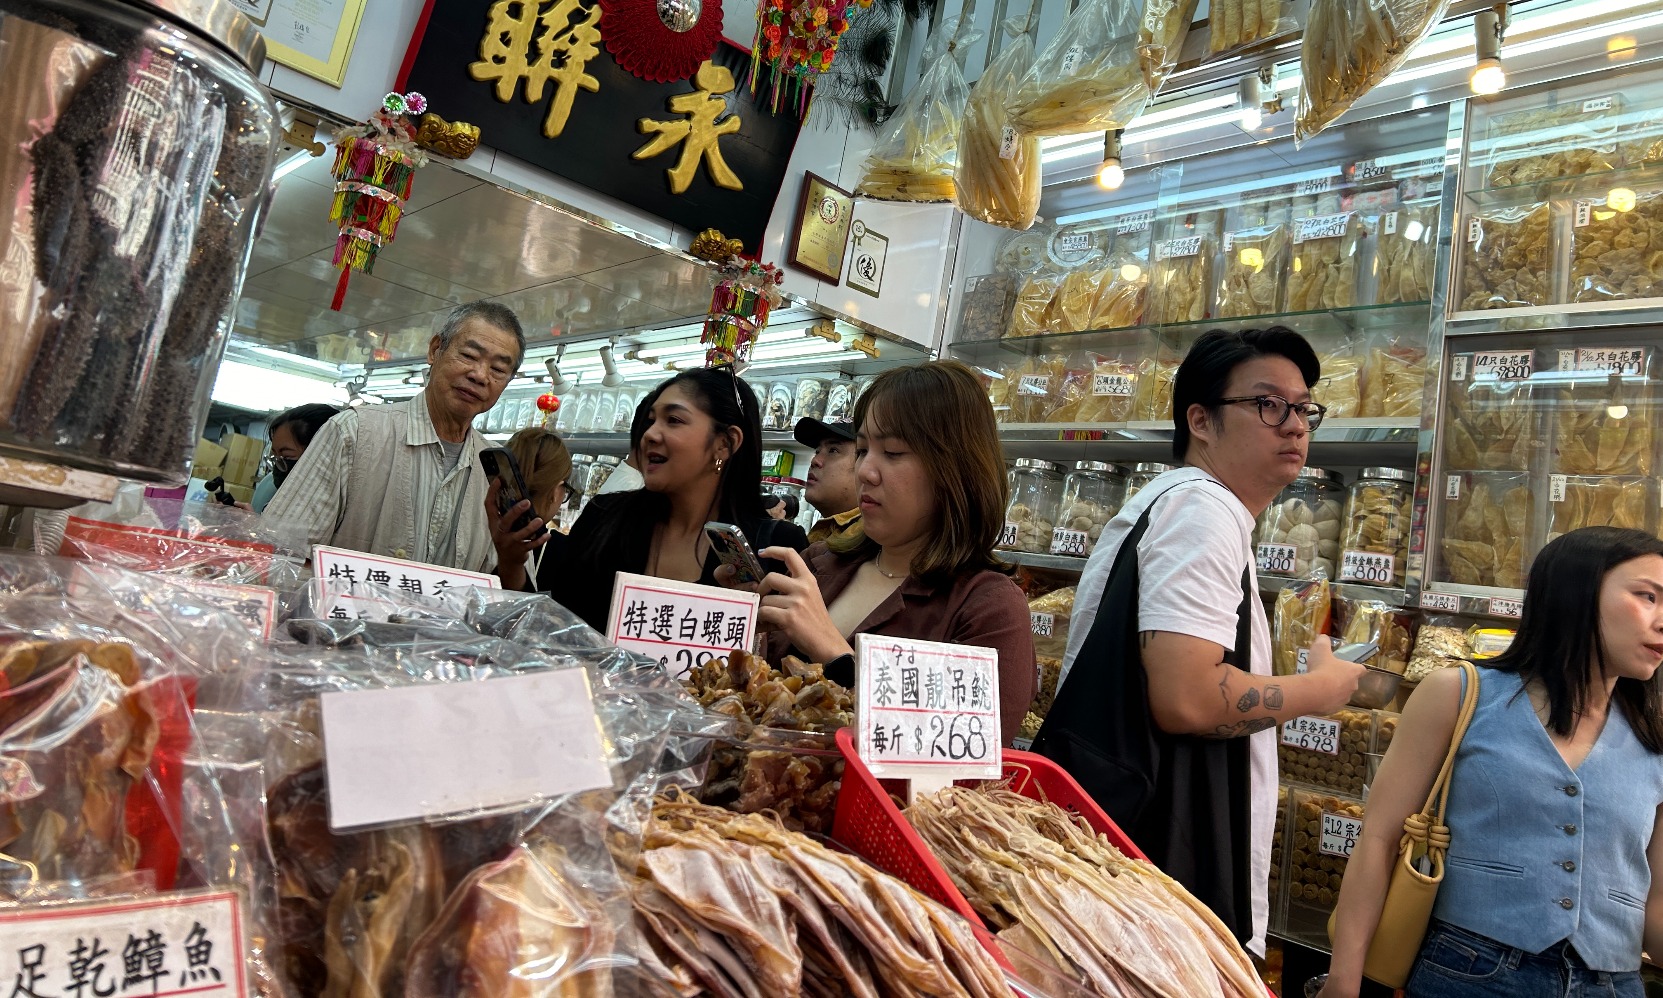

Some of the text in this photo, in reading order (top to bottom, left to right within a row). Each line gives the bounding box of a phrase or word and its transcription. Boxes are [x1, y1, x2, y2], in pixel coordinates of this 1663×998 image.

[1060, 542, 1085, 554] 580
[1355, 565, 1388, 582] 800
[622, 600, 748, 649] 特選白螺頭
[1299, 719, 1337, 738] 宗谷元貝
[872, 723, 904, 756] 每斤
[1322, 841, 1335, 851] 每斤
